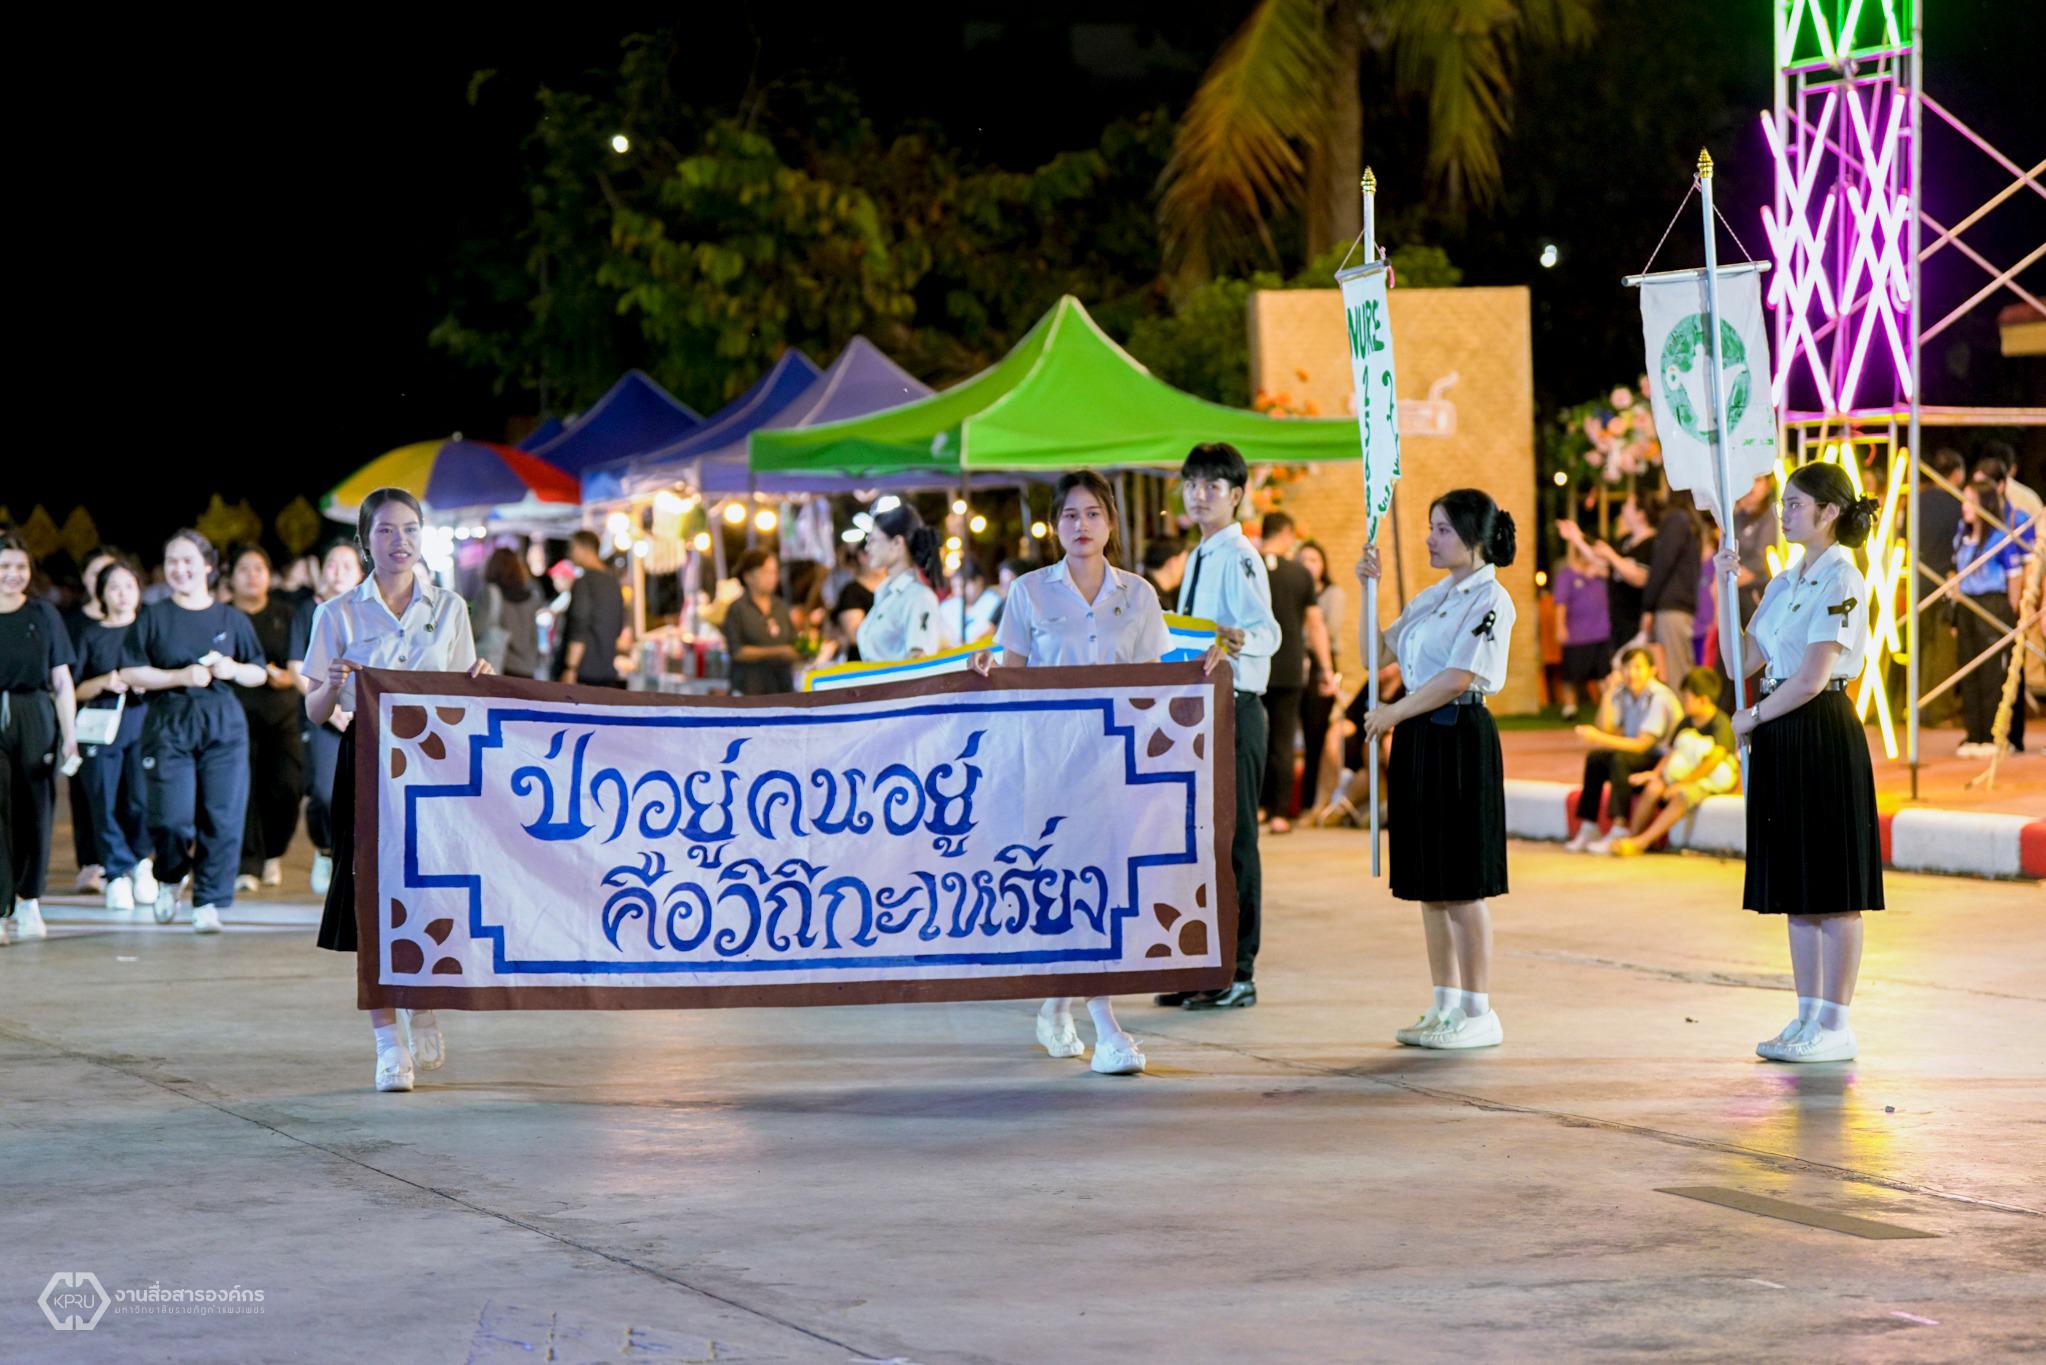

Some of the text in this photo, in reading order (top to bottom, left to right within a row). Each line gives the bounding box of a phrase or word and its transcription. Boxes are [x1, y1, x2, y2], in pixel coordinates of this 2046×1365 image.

[600, 816, 1109, 957] คือวิถีกะเหรี่ยง
